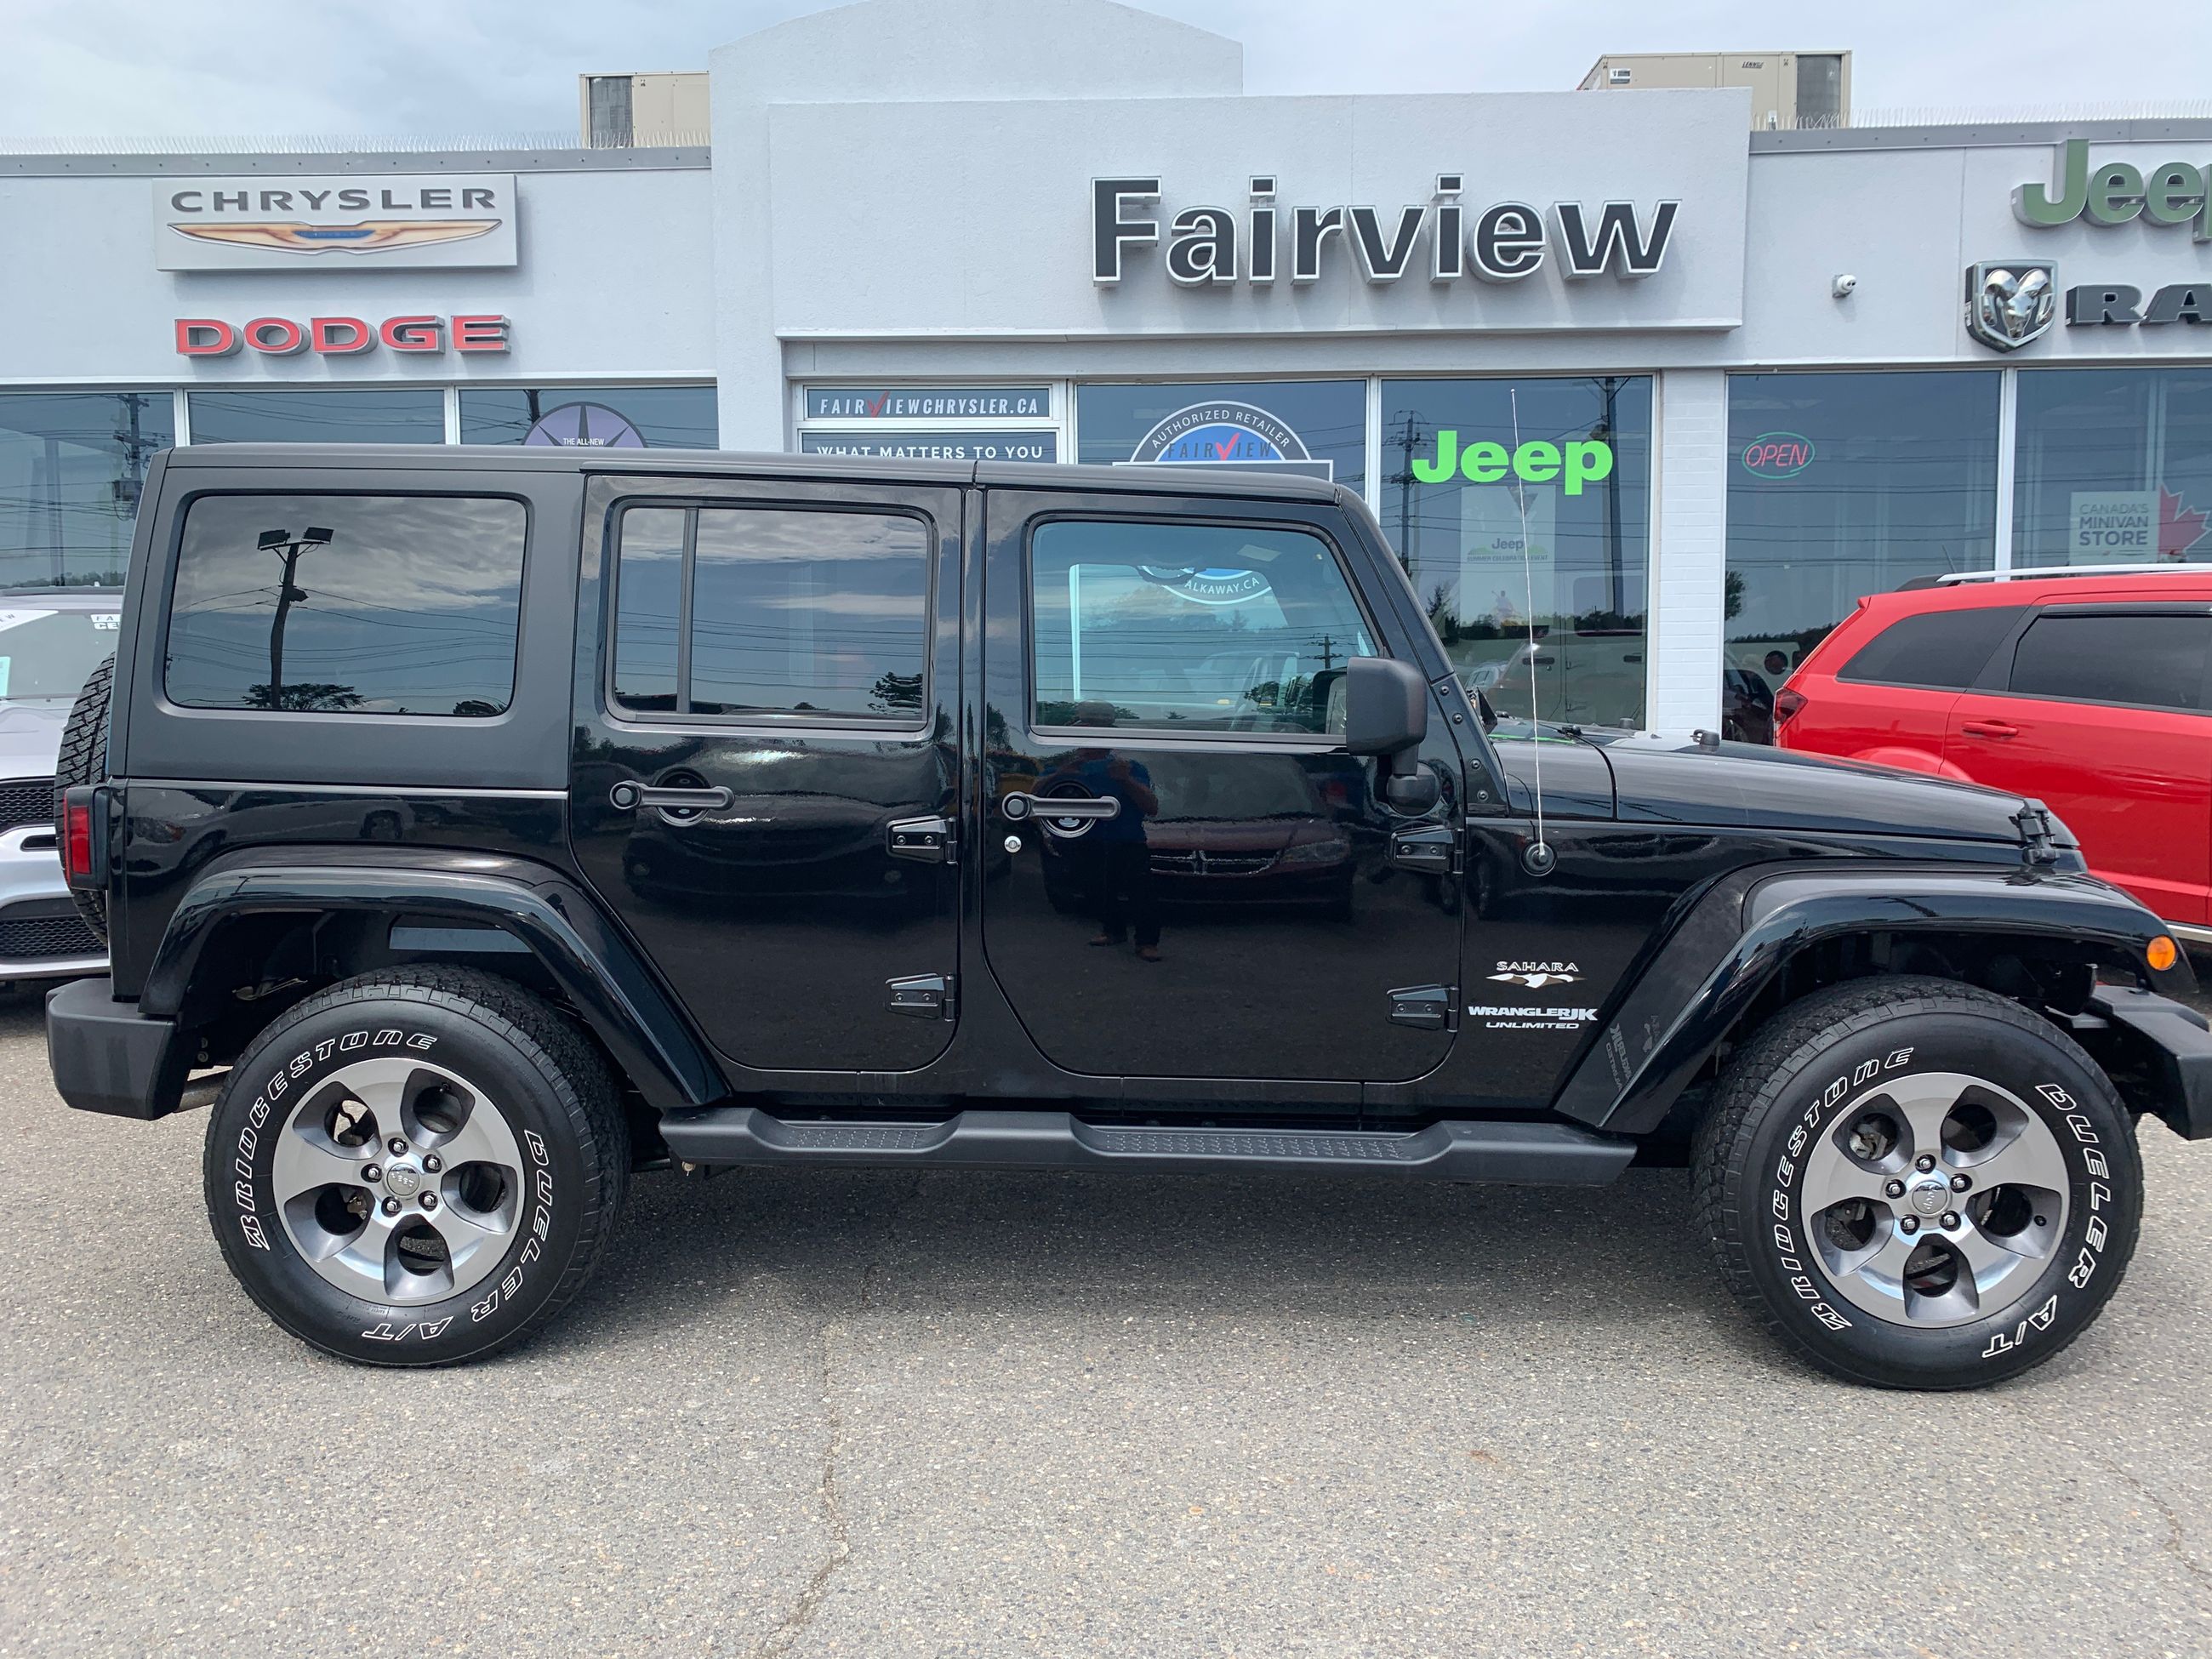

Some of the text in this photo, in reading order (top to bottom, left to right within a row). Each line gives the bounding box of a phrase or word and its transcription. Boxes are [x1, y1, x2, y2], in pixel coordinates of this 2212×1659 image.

[171, 189, 495, 213] CHRYSLER
[1091, 174, 1683, 288] Fairview
[2066, 283, 2212, 327] RA
[175, 315, 510, 357] DODGE
[820, 391, 1038, 417] FAIRVIEWCHRYSLER.CA
[1151, 409, 1290, 449] AUTHORIZED RETAILER
[817, 446, 1042, 459] WHAT MATTERS TO YOU
[1167, 432, 1272, 460] FAIRVIEW
[1746, 444, 1809, 467] OPEN
[1411, 430, 1613, 495] Jeep
[2079, 503, 2149, 515] CANADA'S
[2079, 516, 2149, 529] MINIVAN
[1491, 538, 1525, 551] Jeep
[2078, 530, 2148, 546] STORE
[1184, 576, 1259, 595] ALKAWAY.CA
[1496, 961, 1579, 972] SAHARA
[231, 1029, 438, 1251] BRIDGESTONE
[1772, 1046, 1914, 1331] BRIDGESTONE
[1981, 1083, 2112, 1359] DUELER A/T
[362, 1129, 553, 1341] DUELER A/T
